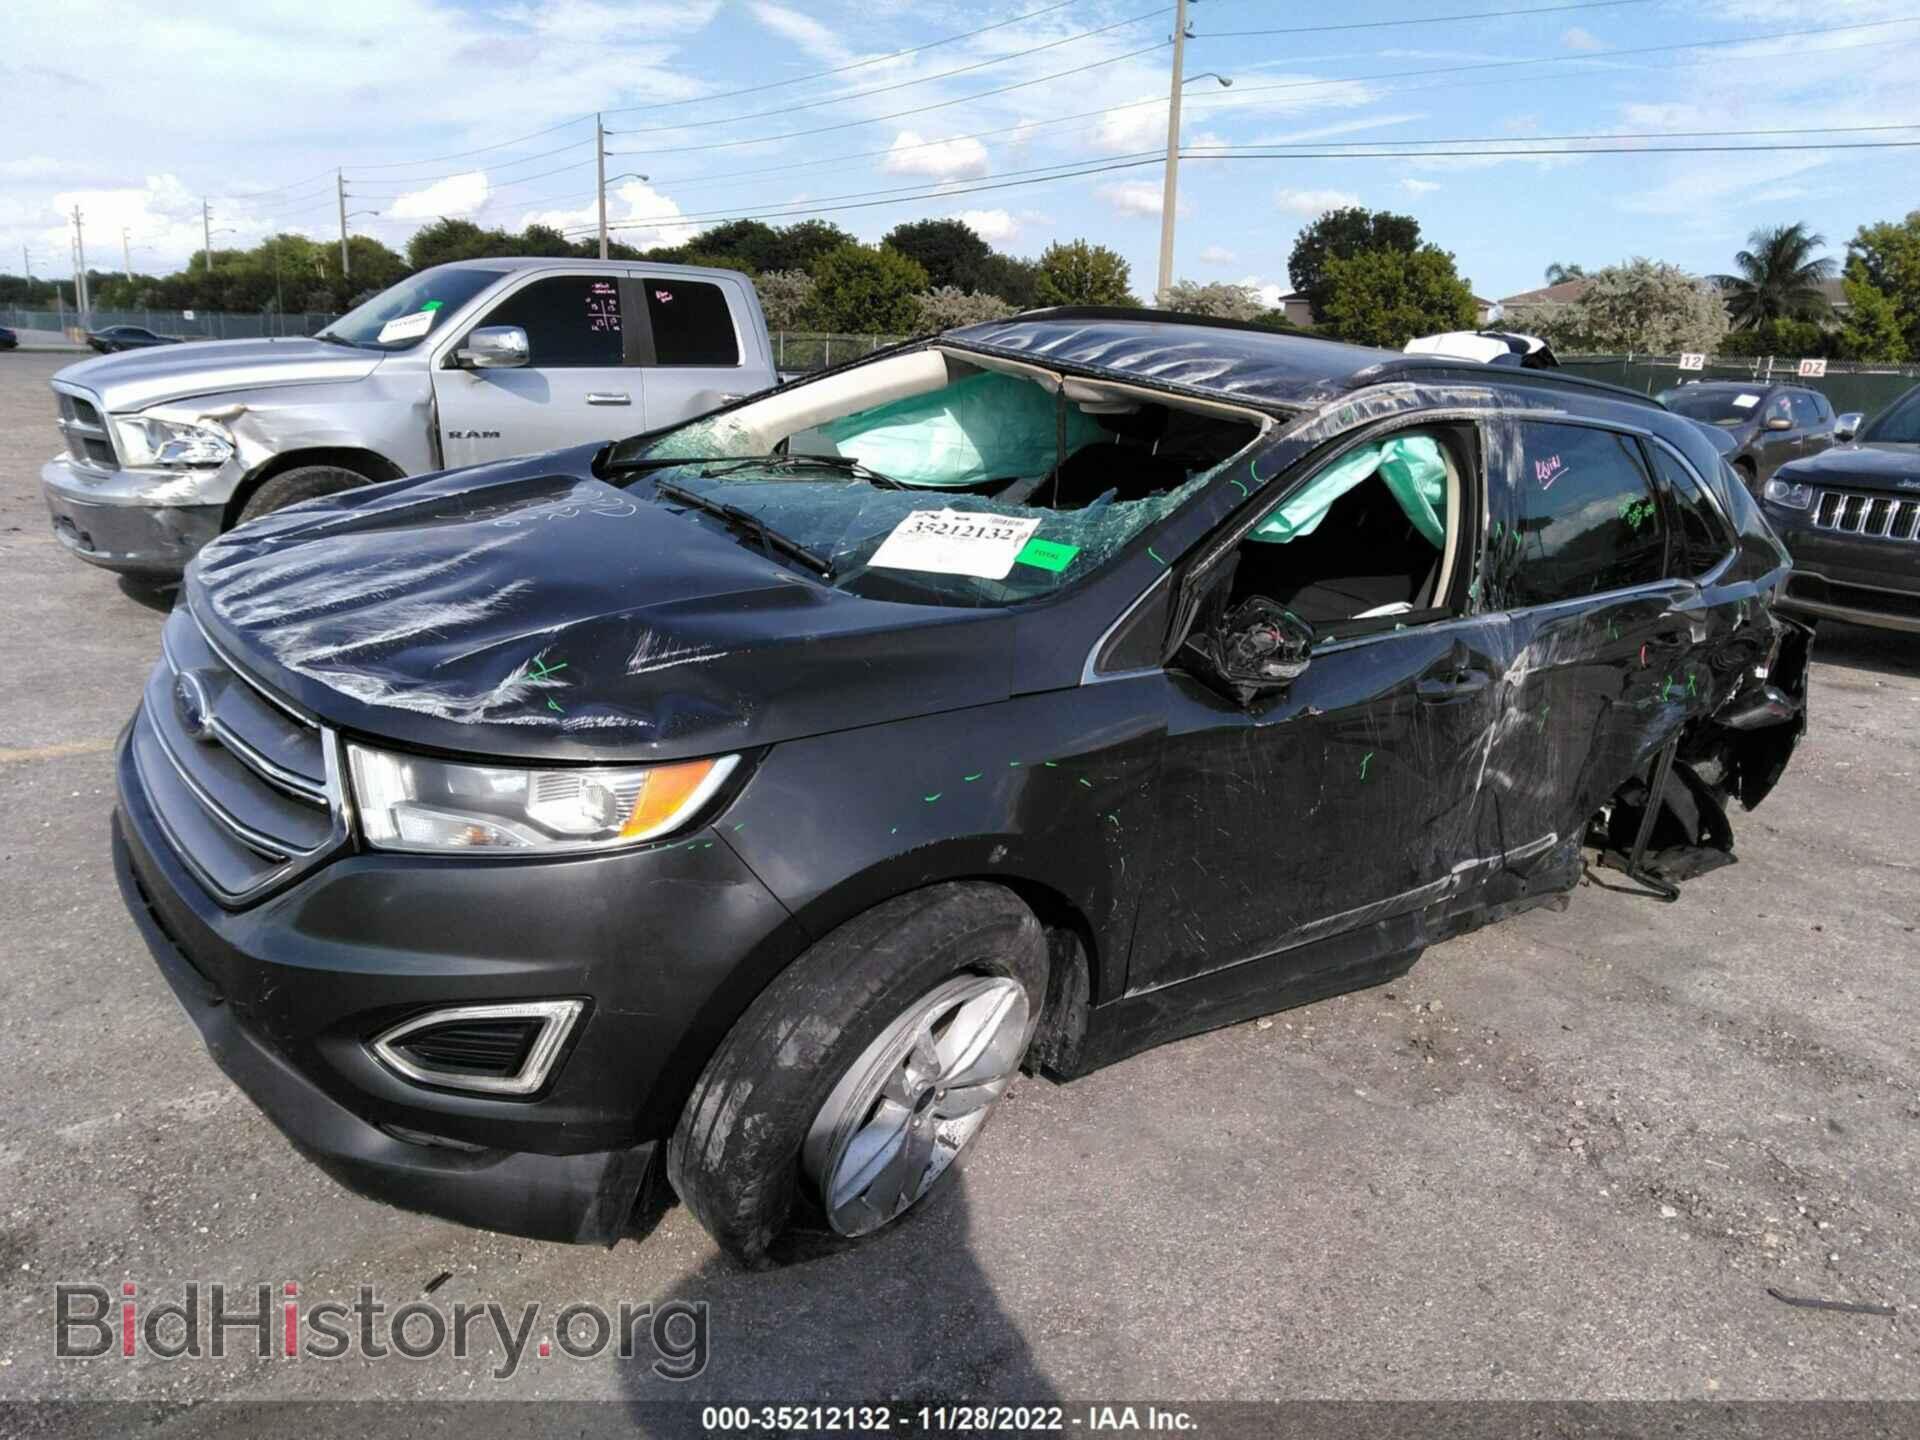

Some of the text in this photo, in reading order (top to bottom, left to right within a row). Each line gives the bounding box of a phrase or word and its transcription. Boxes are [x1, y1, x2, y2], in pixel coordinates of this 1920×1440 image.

[1682, 355, 1702, 369] 12
[448, 431, 501, 440] RAM
[908, 521, 1014, 541] 35212132
